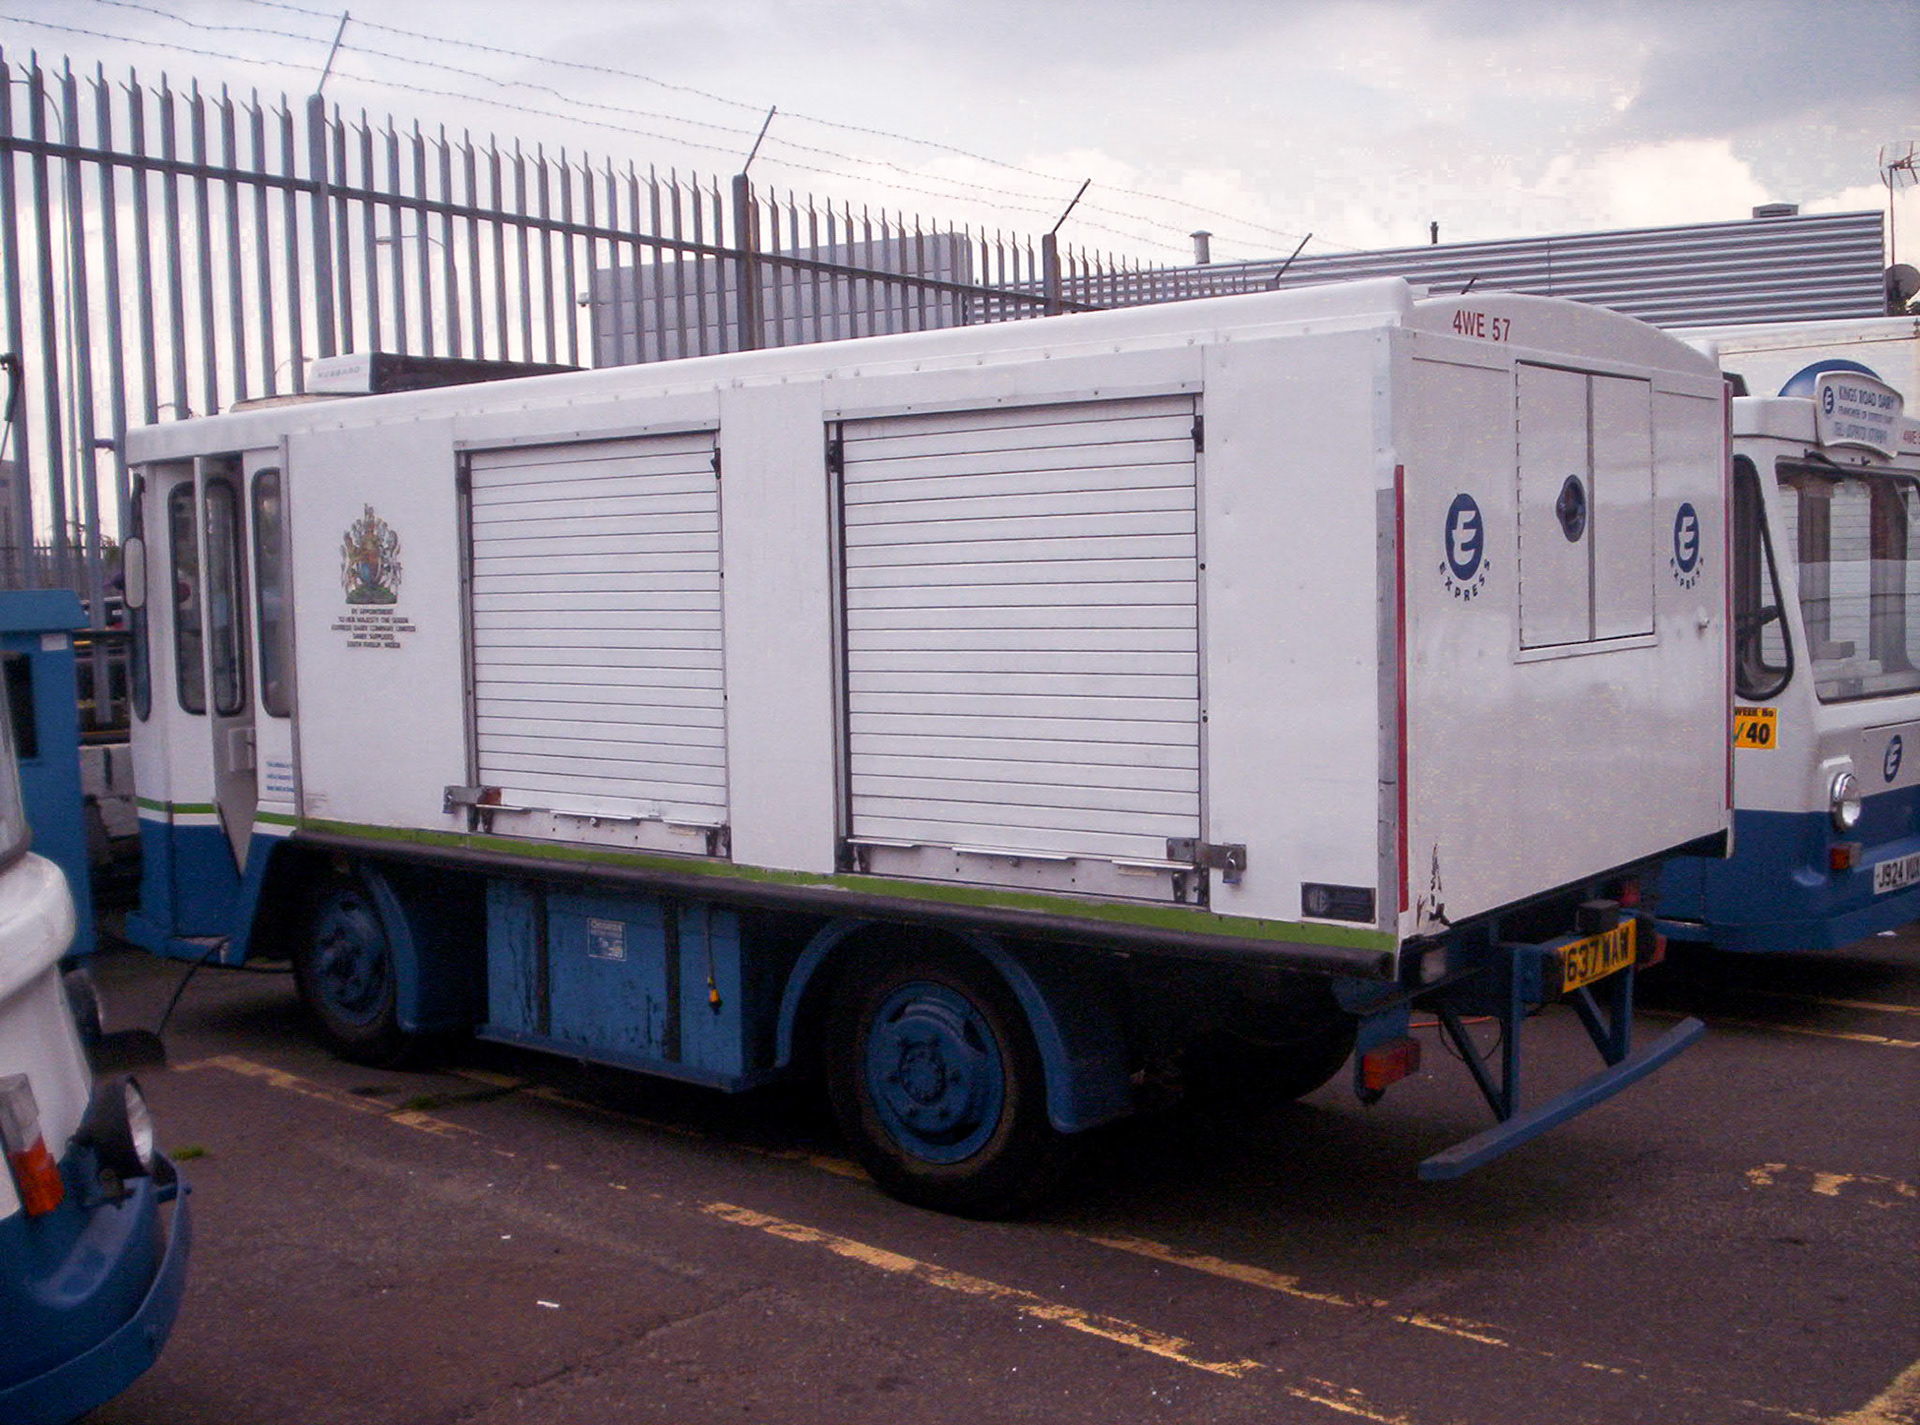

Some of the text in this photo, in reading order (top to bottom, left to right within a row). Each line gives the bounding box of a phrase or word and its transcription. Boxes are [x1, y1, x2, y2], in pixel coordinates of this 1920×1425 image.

[1453, 309, 1511, 341] 4WE 57
[1439, 558, 1491, 602] EXPRESS
[1746, 722, 1770, 745] 40
[1879, 860, 1904, 888] J924
